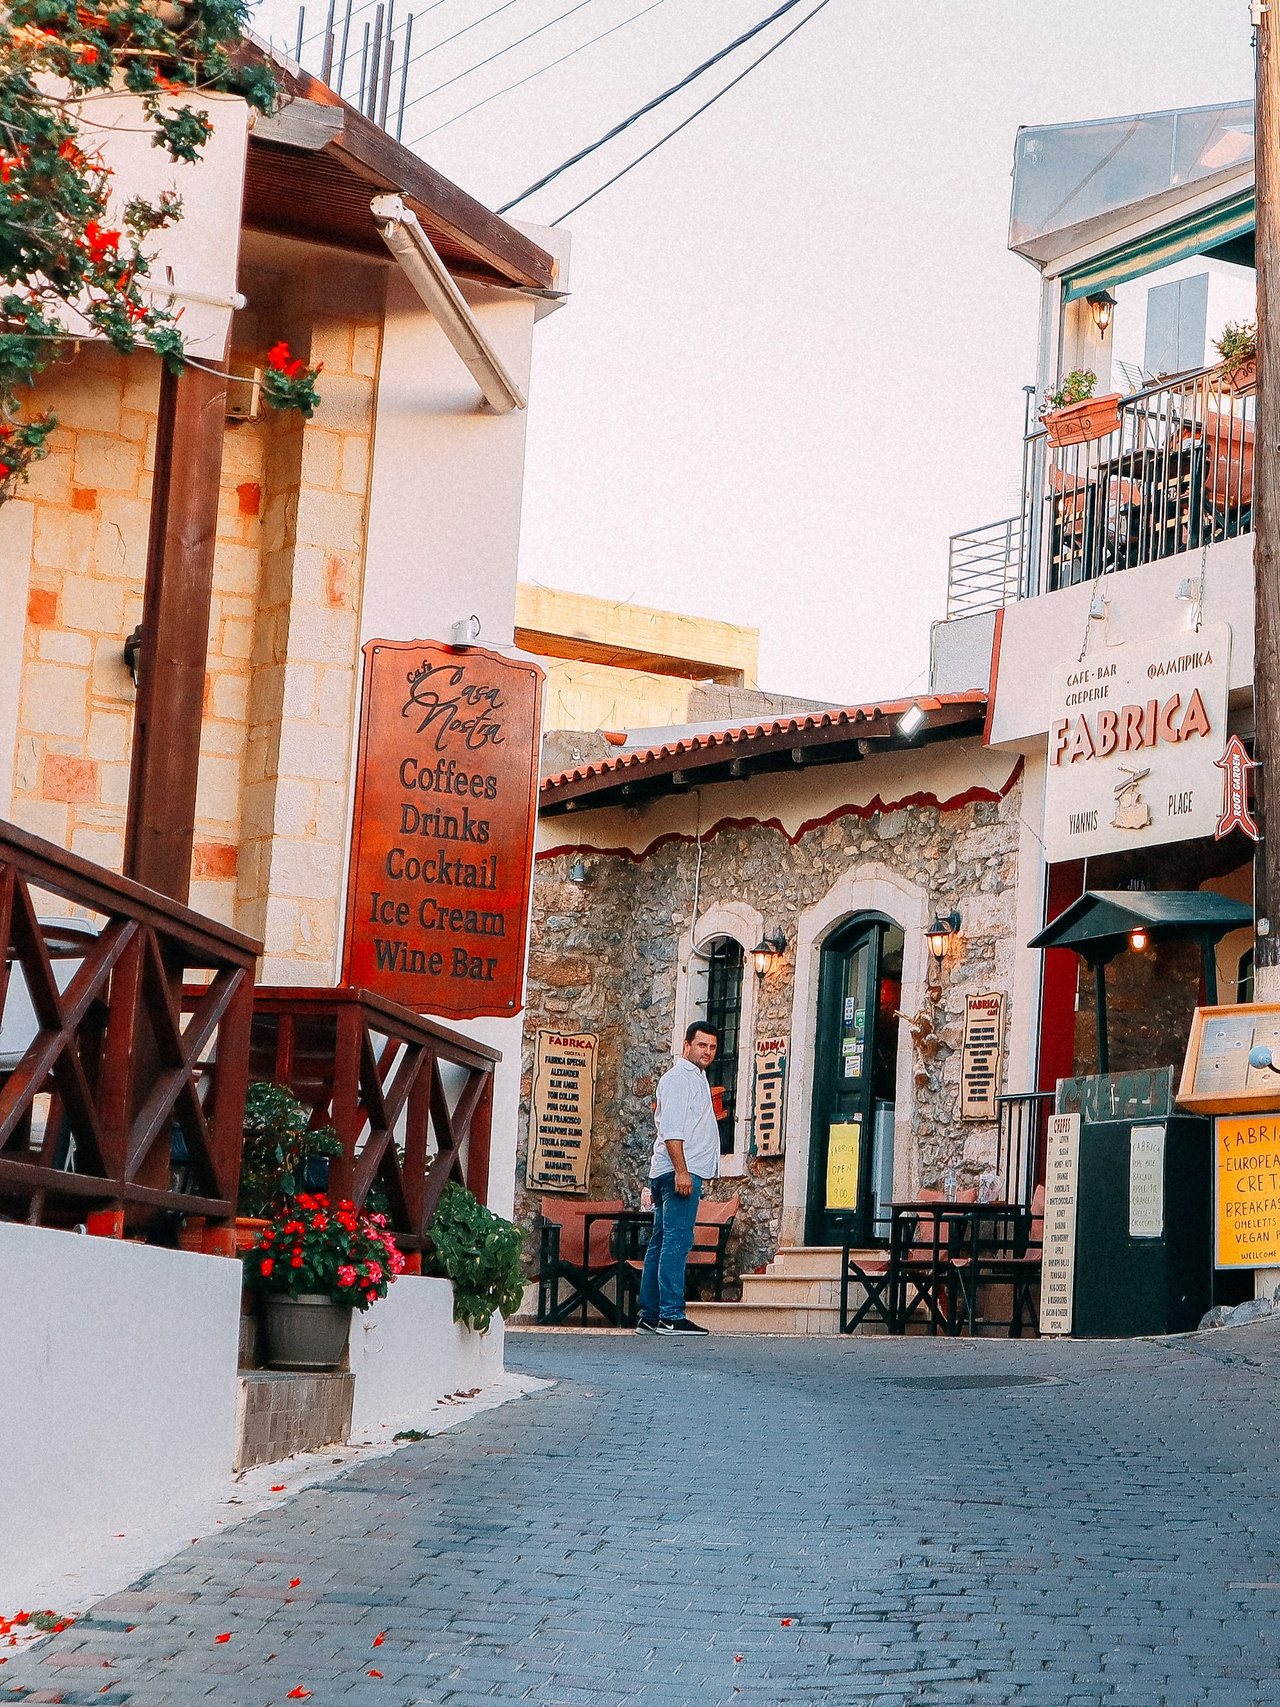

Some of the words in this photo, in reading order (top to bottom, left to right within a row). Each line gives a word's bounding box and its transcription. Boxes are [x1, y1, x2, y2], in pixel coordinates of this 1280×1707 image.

[1067, 670, 1089, 687] CAFE
[1097, 664, 1117, 680] BAR
[1147, 651, 1213, 680] ΦΑΜΠΡΙΚΑ
[409, 664, 505, 709] Casa
[1065, 685, 1109, 707] CREPERIE
[401, 691, 506, 752] Nostra
[1050, 688, 1211, 767] FABRICA
[399, 757, 498, 801] Coffees
[1232, 753, 1241, 791] GARDEN
[1069, 810, 1099, 836] YIANNIS
[1168, 791, 1194, 817] PLACE
[1233, 792, 1242, 817] ROOF
[399, 803, 490, 846] Drinks
[385, 848, 498, 891] Cocktail
[369, 892, 410, 926] Ice
[419, 898, 506, 937] Cream
[374, 939, 443, 976] Wine
[450, 947, 498, 981] Bar
[969, 999, 999, 1010] FABRICA
[549, 1036, 593, 1050] FABRICA
[757, 1039, 785, 1052] FABRICA
[1060, 1070, 1169, 1121] CREPES
[832, 1163, 852, 1175] OPEN
[1234, 1217, 1277, 1230] OMELETTS
[1235, 1231, 1270, 1243] VEGAN
[1241, 1250, 1277, 1260] WELLCOME
